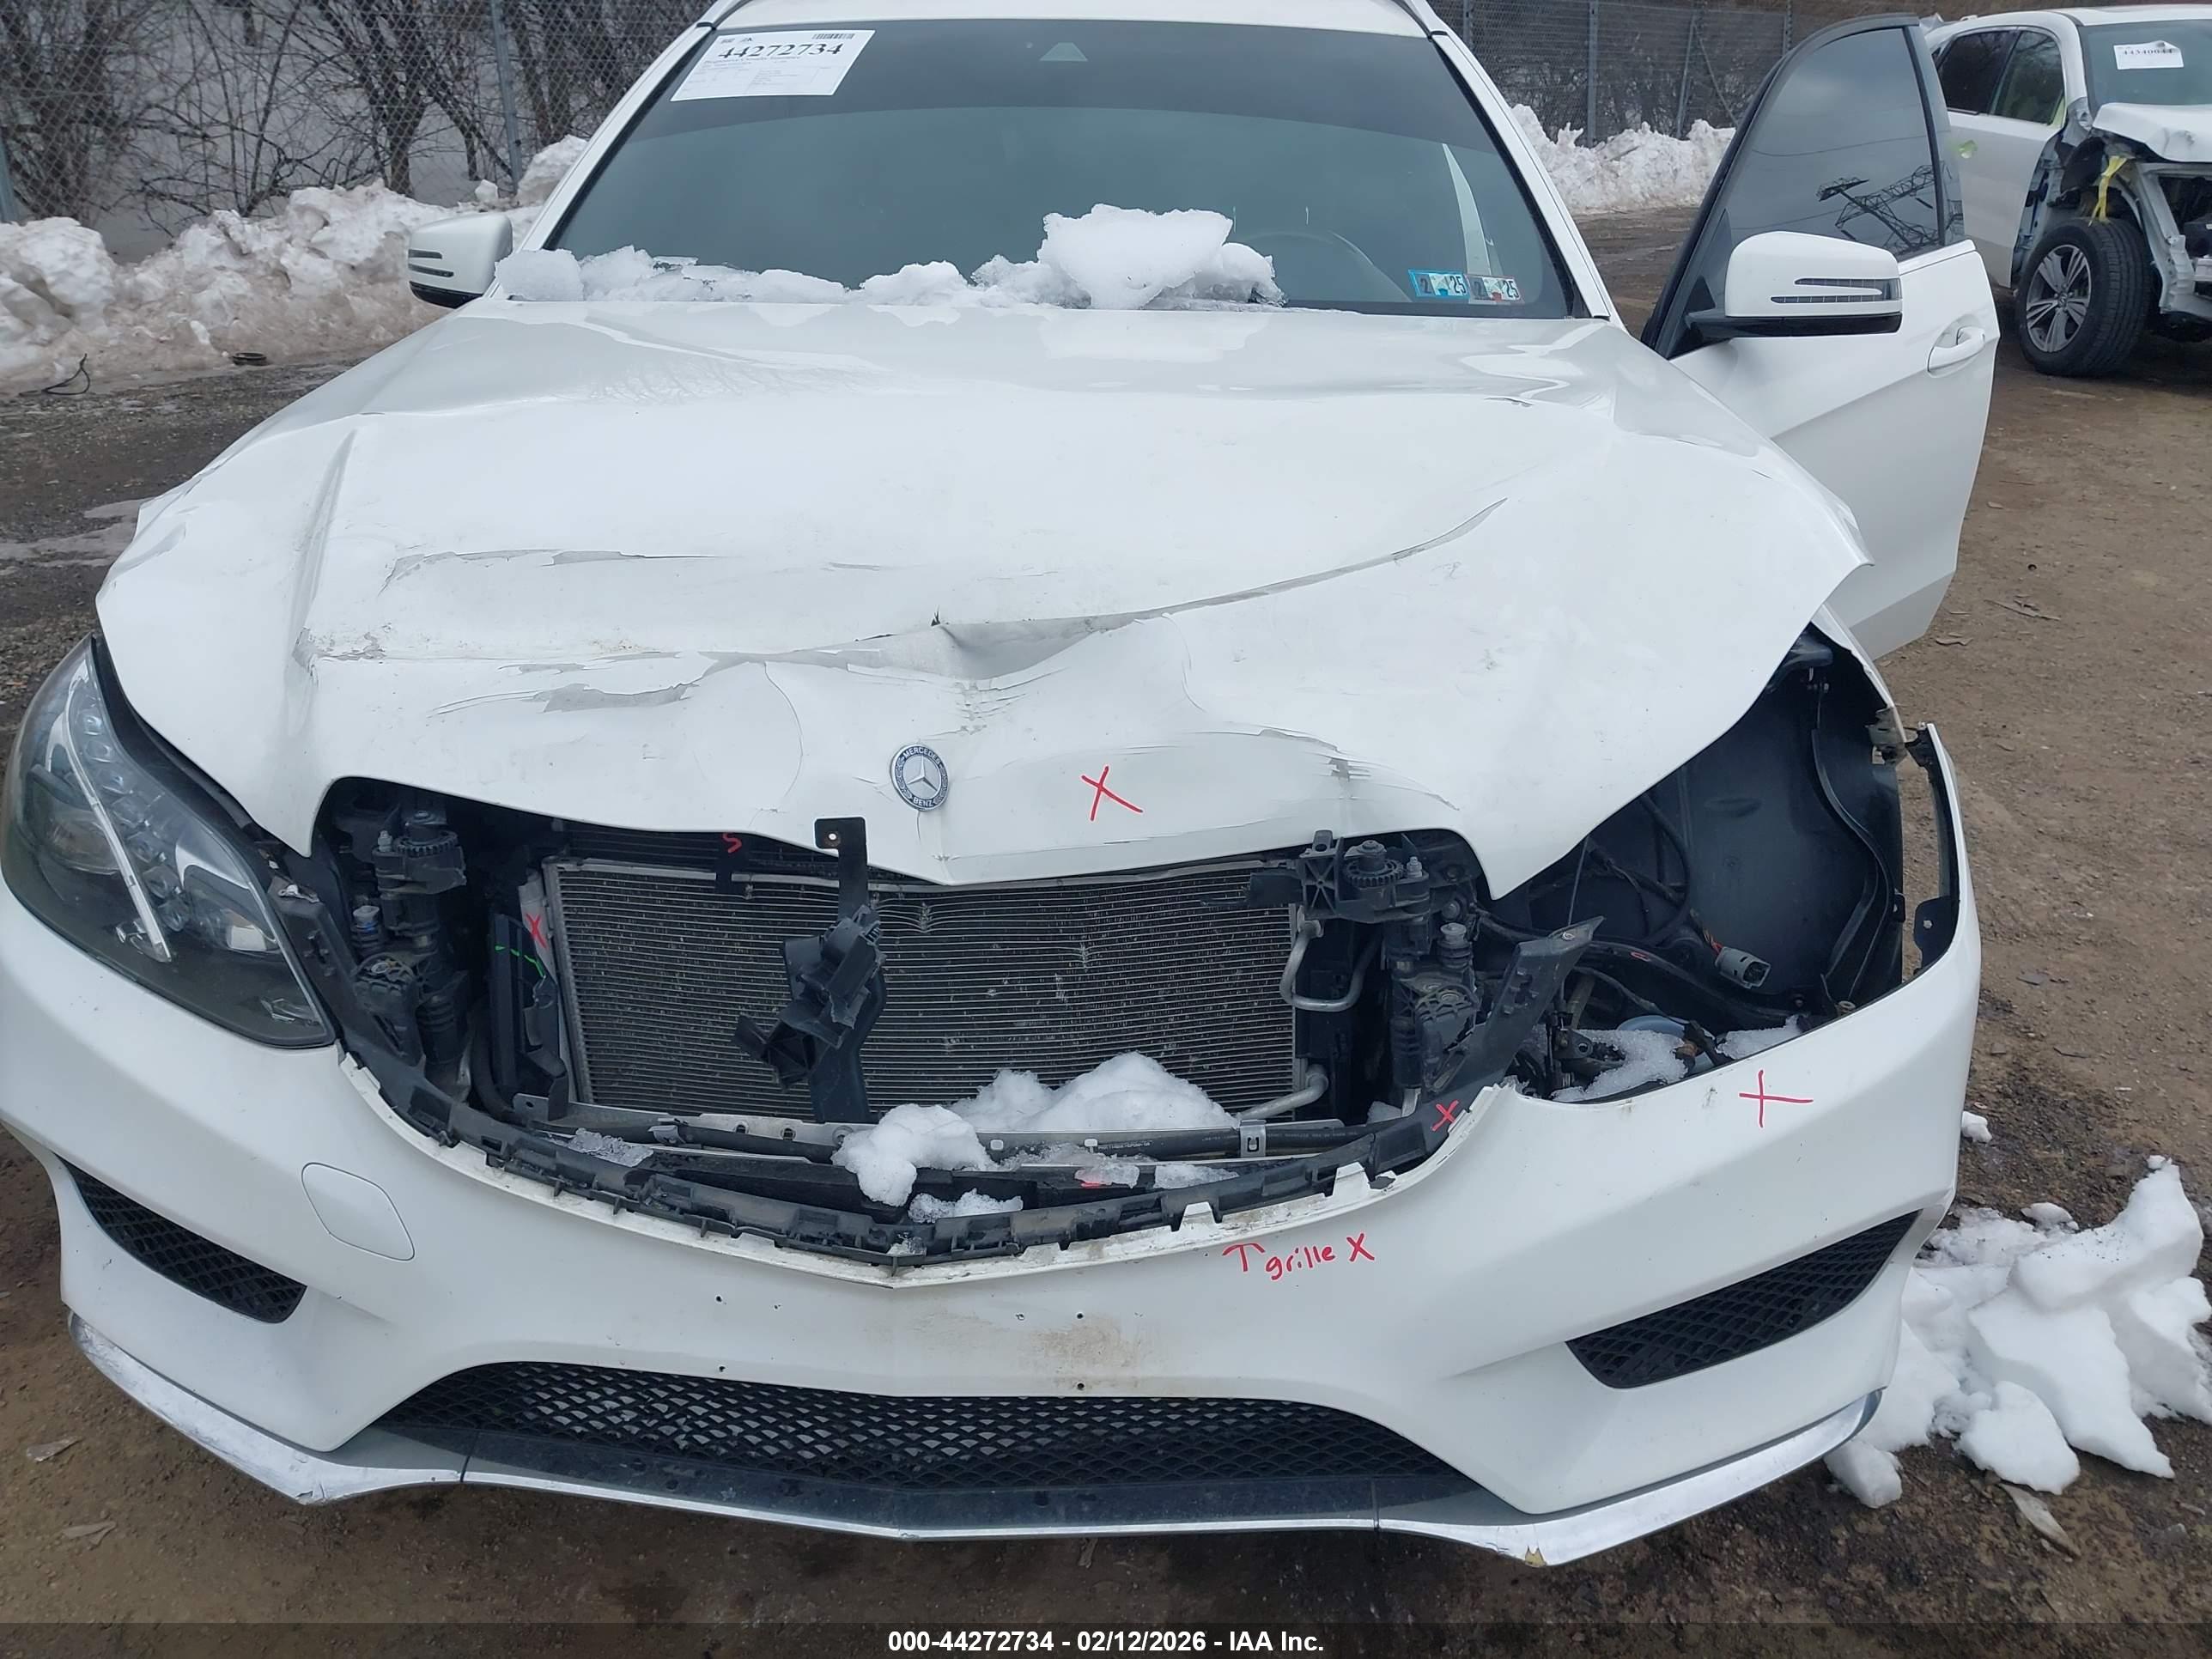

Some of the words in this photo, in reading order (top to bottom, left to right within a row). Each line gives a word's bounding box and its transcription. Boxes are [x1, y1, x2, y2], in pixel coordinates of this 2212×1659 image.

[718, 42, 844, 59] 44272734
[1420, 277, 1431, 295] 2
[1449, 275, 1467, 294] 25
[1502, 280, 1520, 299] 25
[913, 796, 934, 807] BENZ
[1265, 1245, 1336, 1281] grille
[1346, 1232, 1375, 1262] X
